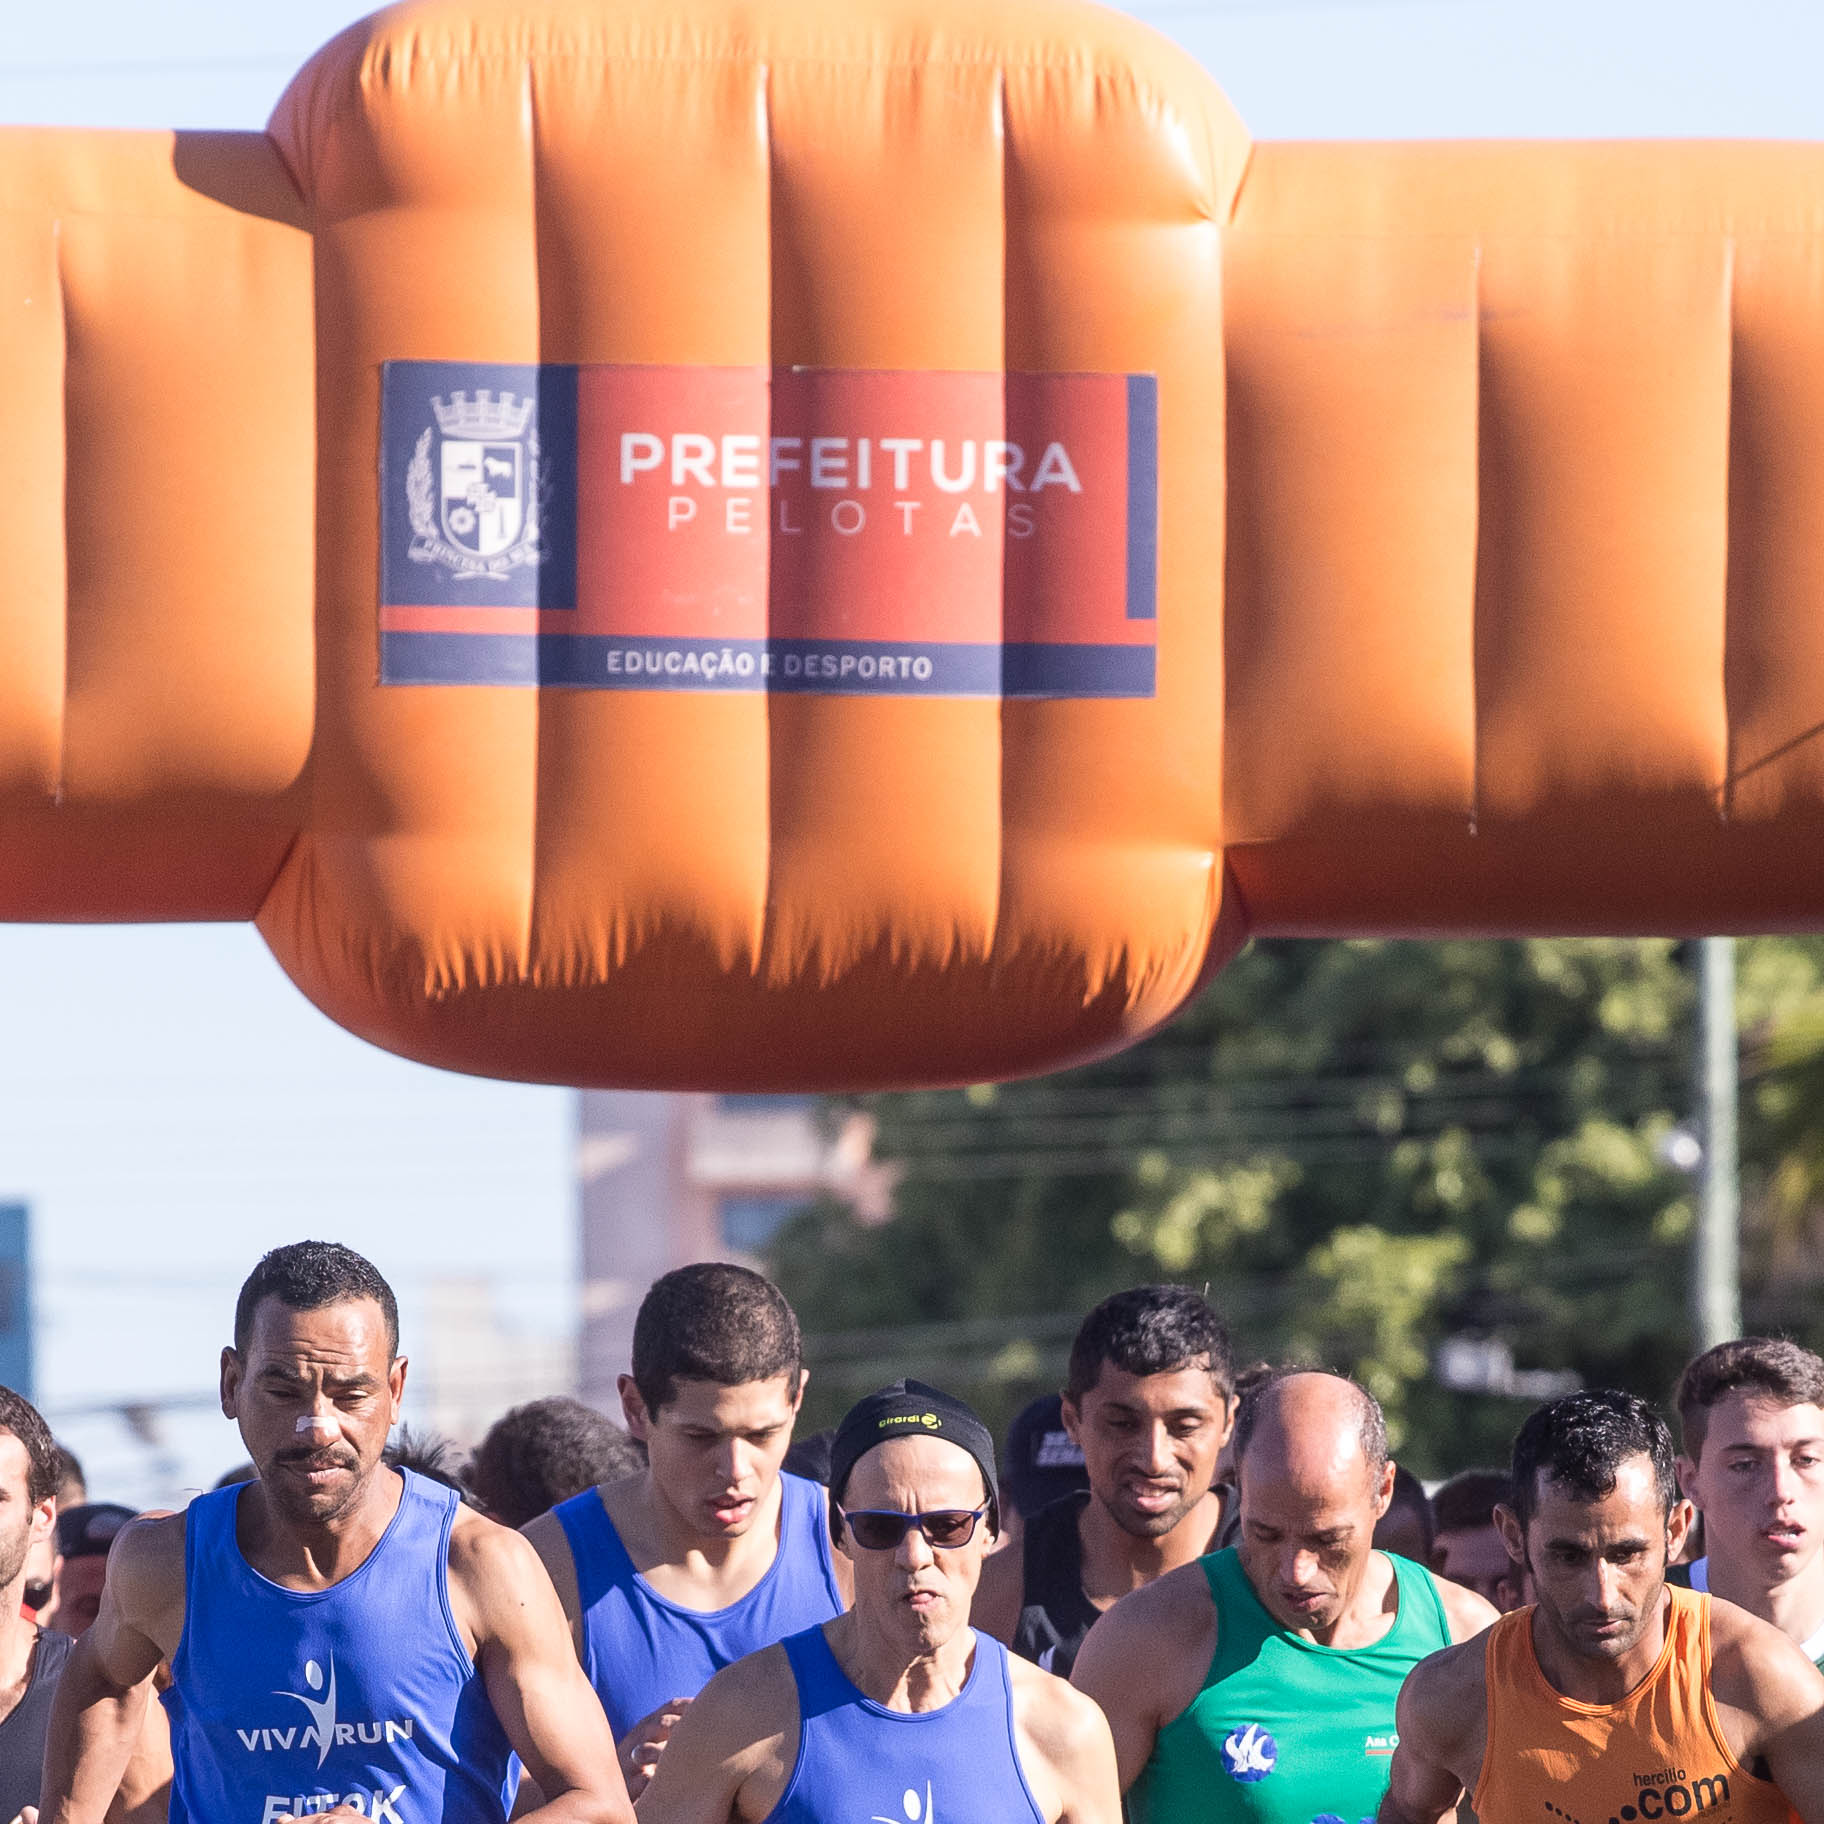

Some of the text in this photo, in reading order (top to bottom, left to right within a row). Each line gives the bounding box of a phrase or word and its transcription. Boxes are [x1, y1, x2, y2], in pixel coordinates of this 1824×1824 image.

[619, 432, 1083, 493] PREFEITURA
[668, 495, 1036, 537] PELOTAS
[606, 646, 755, 682] EDUCAÇÃO
[783, 654, 934, 682] DESPORTO
[334, 1719, 414, 1746] RUN
